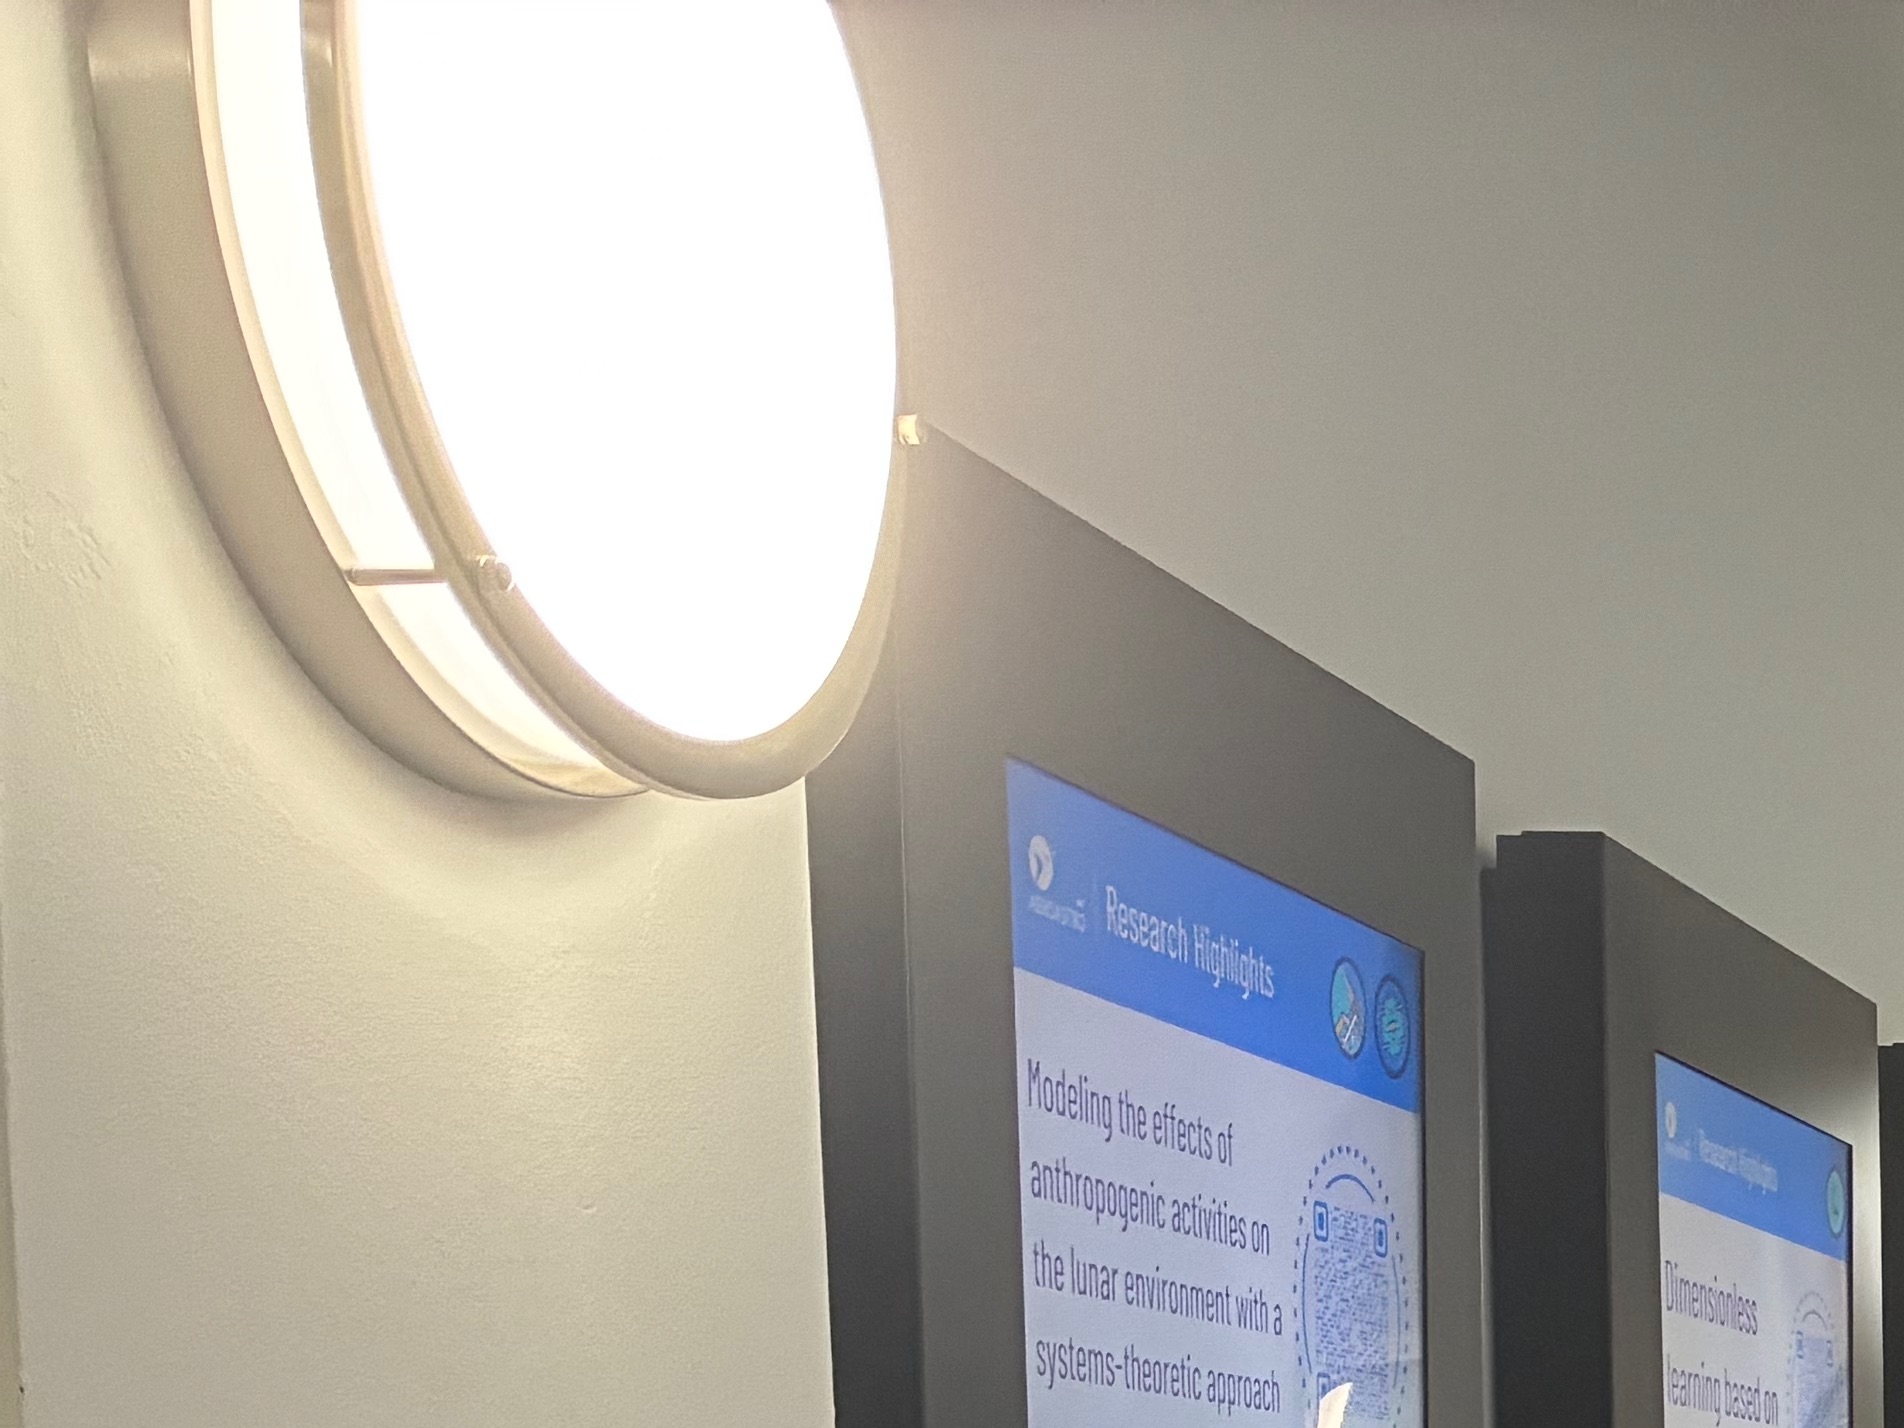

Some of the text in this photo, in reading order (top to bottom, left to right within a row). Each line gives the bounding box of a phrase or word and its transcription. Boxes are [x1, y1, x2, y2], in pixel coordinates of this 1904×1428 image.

[1105, 883, 1190, 967] Research
[1193, 920, 1275, 1003] Highlights
[1026, 1057, 1234, 1167] Modeling the effects of
[1030, 1152, 1270, 1255] anthropogenic activities on
[1032, 1236, 1283, 1340] the lunar environment with a
[1664, 1258, 1758, 1336] Dimensionless
[1035, 1332, 1280, 1418] systems-theoretic approach
[1666, 1353, 1779, 1428] learning based on
